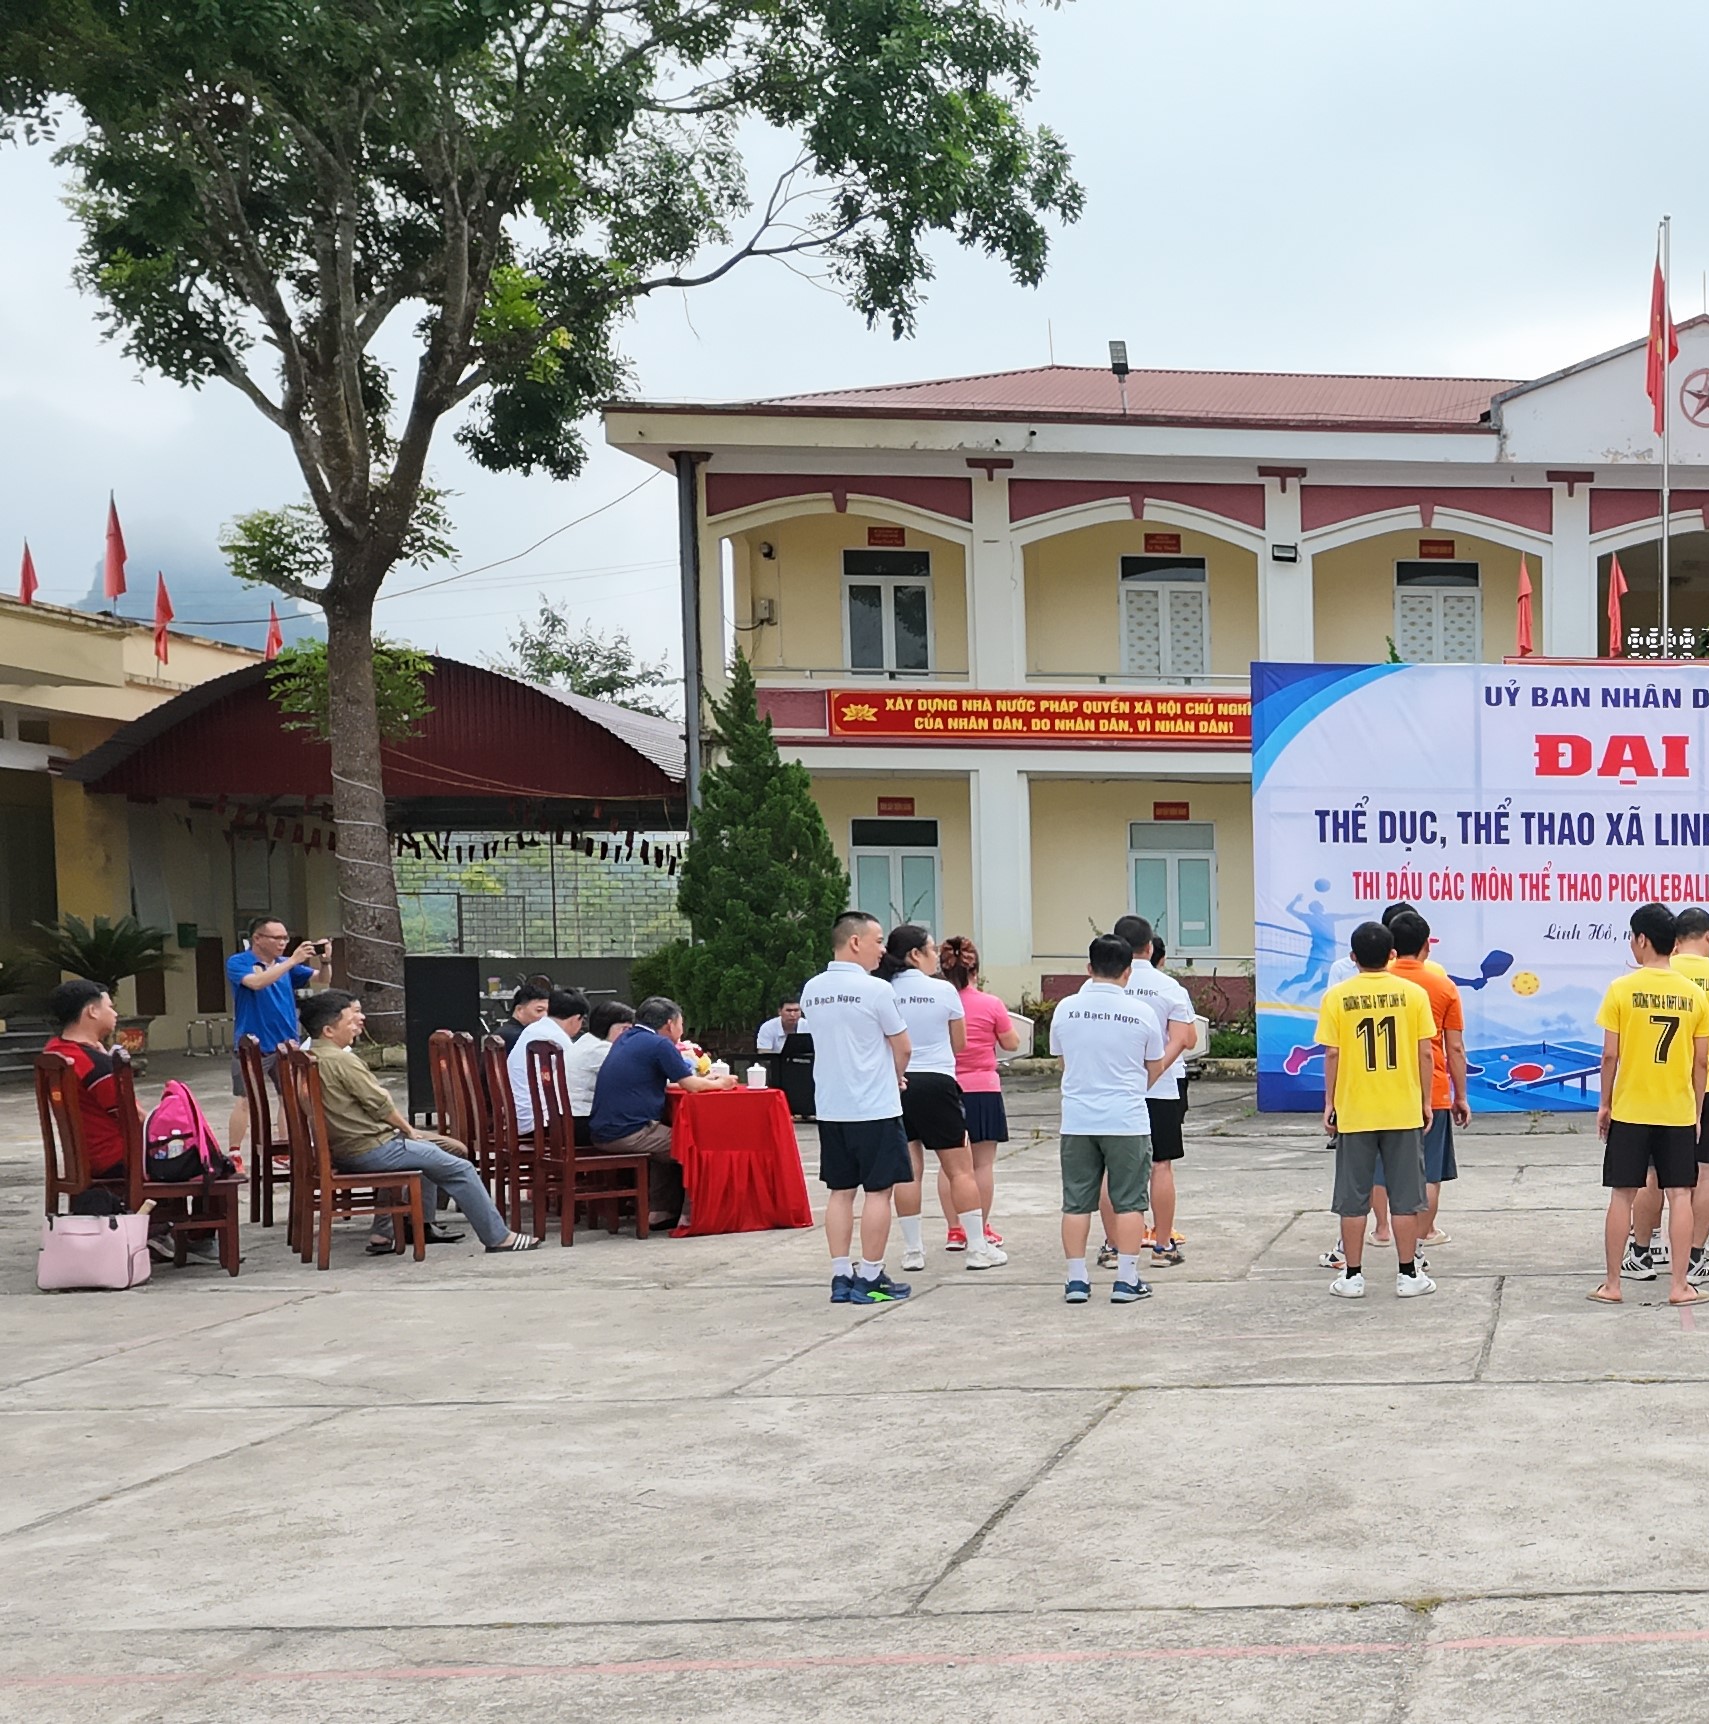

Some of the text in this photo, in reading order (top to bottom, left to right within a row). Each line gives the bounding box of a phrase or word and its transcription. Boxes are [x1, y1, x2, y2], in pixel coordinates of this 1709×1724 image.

[885, 697, 914, 711] XÂY
[917, 698, 958, 714] DỰNG
[962, 697, 993, 712] NHÀ
[996, 697, 1036, 713] NƯỚC
[1040, 697, 1079, 713] PHÁP
[1134, 699, 1153, 714] XÃ
[1157, 701, 1182, 717] HỘI
[1185, 698, 1214, 715] CHỦ
[1484, 679, 1521, 708] UỶ
[1531, 686, 1591, 708] BAN
[1601, 682, 1682, 709] NHÂN
[914, 713, 1234, 734] CỦA NHÂN DÂN, DO NHÂN DÂN, VÌ NHÂN DÂN!
[1534, 734, 1690, 785] ĐẠI
[1314, 795, 1370, 844] THỂ
[1378, 810, 1447, 852] DỤC,
[1456, 797, 1512, 845] THỂ
[1520, 811, 1595, 846] THAO
[1605, 805, 1645, 846] XÃ
[1352, 871, 1380, 900] THI
[1386, 861, 1423, 901] ĐẤU
[1428, 866, 1465, 901] CÁC
[1471, 866, 1513, 901] MÔN
[1518, 861, 1552, 902] THỂ
[1556, 872, 1603, 902] THAO
[1543, 922, 1581, 941] Linh
[1356, 1015, 1398, 1073] 11
[1649, 1015, 1681, 1065] 7
